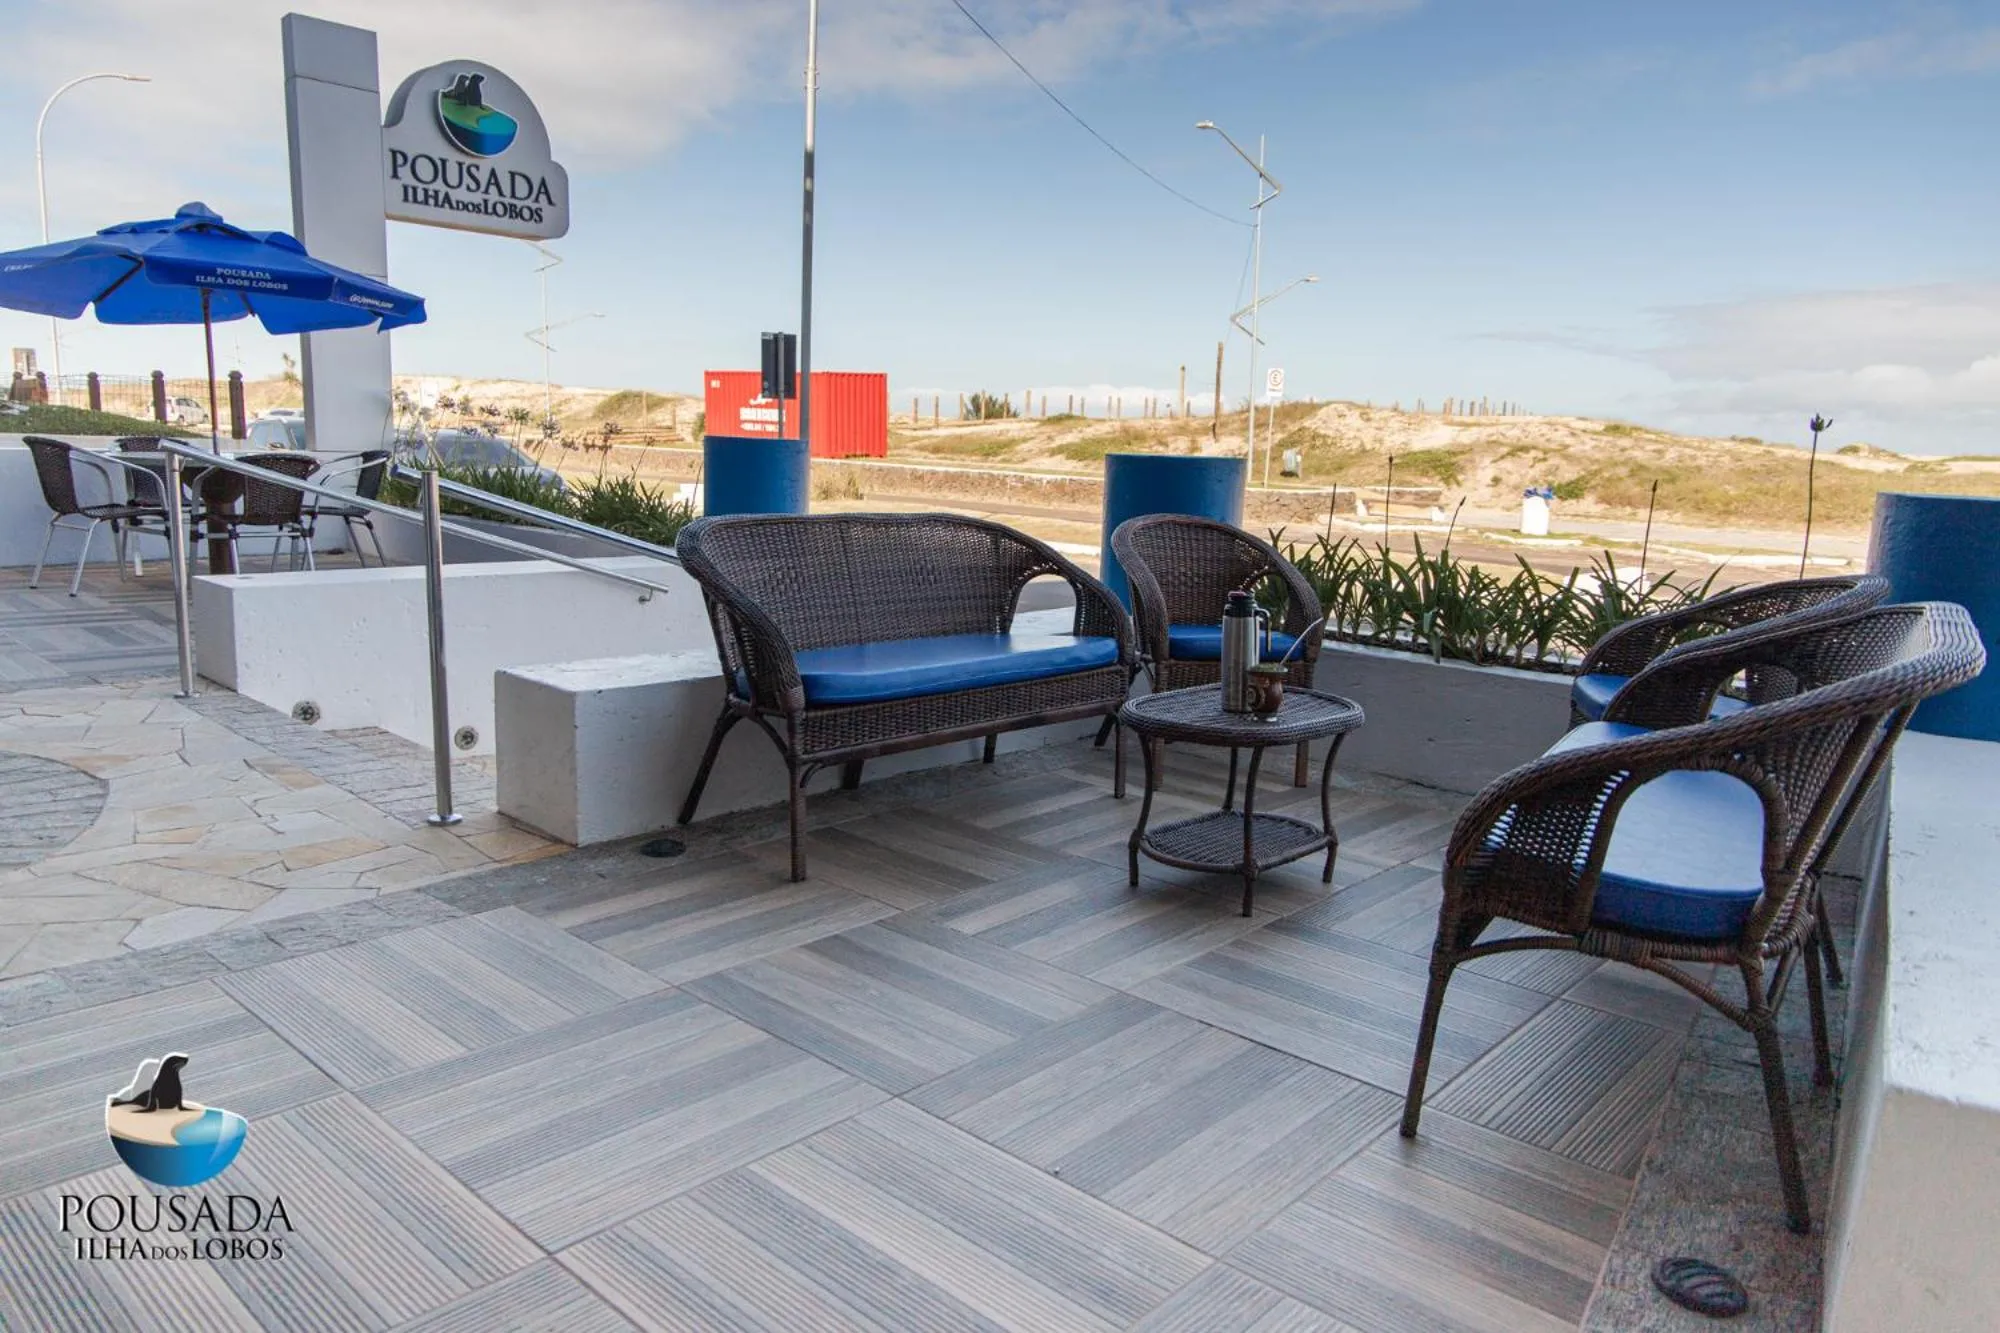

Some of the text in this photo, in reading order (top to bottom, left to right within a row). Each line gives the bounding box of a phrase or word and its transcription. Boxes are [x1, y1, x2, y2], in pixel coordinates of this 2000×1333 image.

[389, 148, 556, 207] POUSADA
[216, 267, 271, 280] POUSADA
[195, 275, 289, 291] ILHA DOS LOBOS
